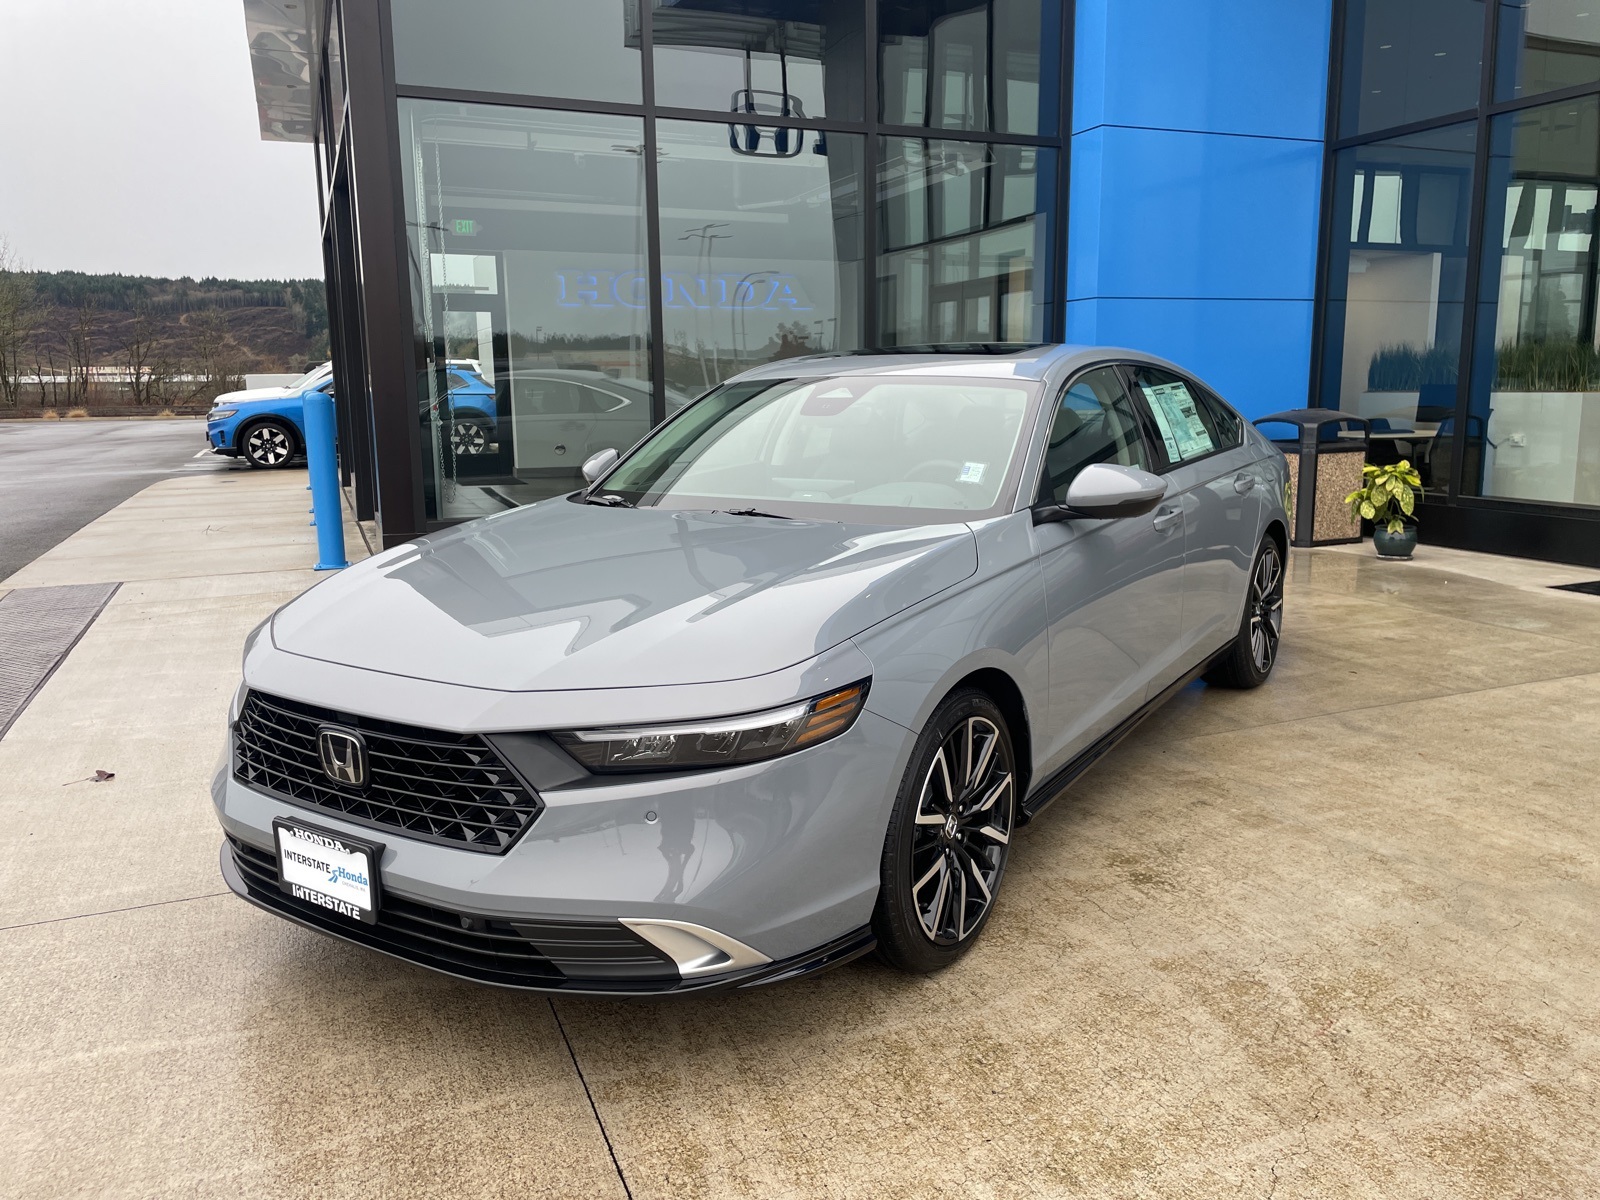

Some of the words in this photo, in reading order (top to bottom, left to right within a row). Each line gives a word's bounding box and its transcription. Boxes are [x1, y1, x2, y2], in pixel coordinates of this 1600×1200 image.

[455, 219, 473, 233] EXIT
[555, 269, 815, 311] HONDA
[293, 827, 347, 853] HONDA
[284, 848, 332, 874] INTERSTATE
[337, 866, 369, 887] Honda
[292, 883, 361, 921] INTERSTATE
